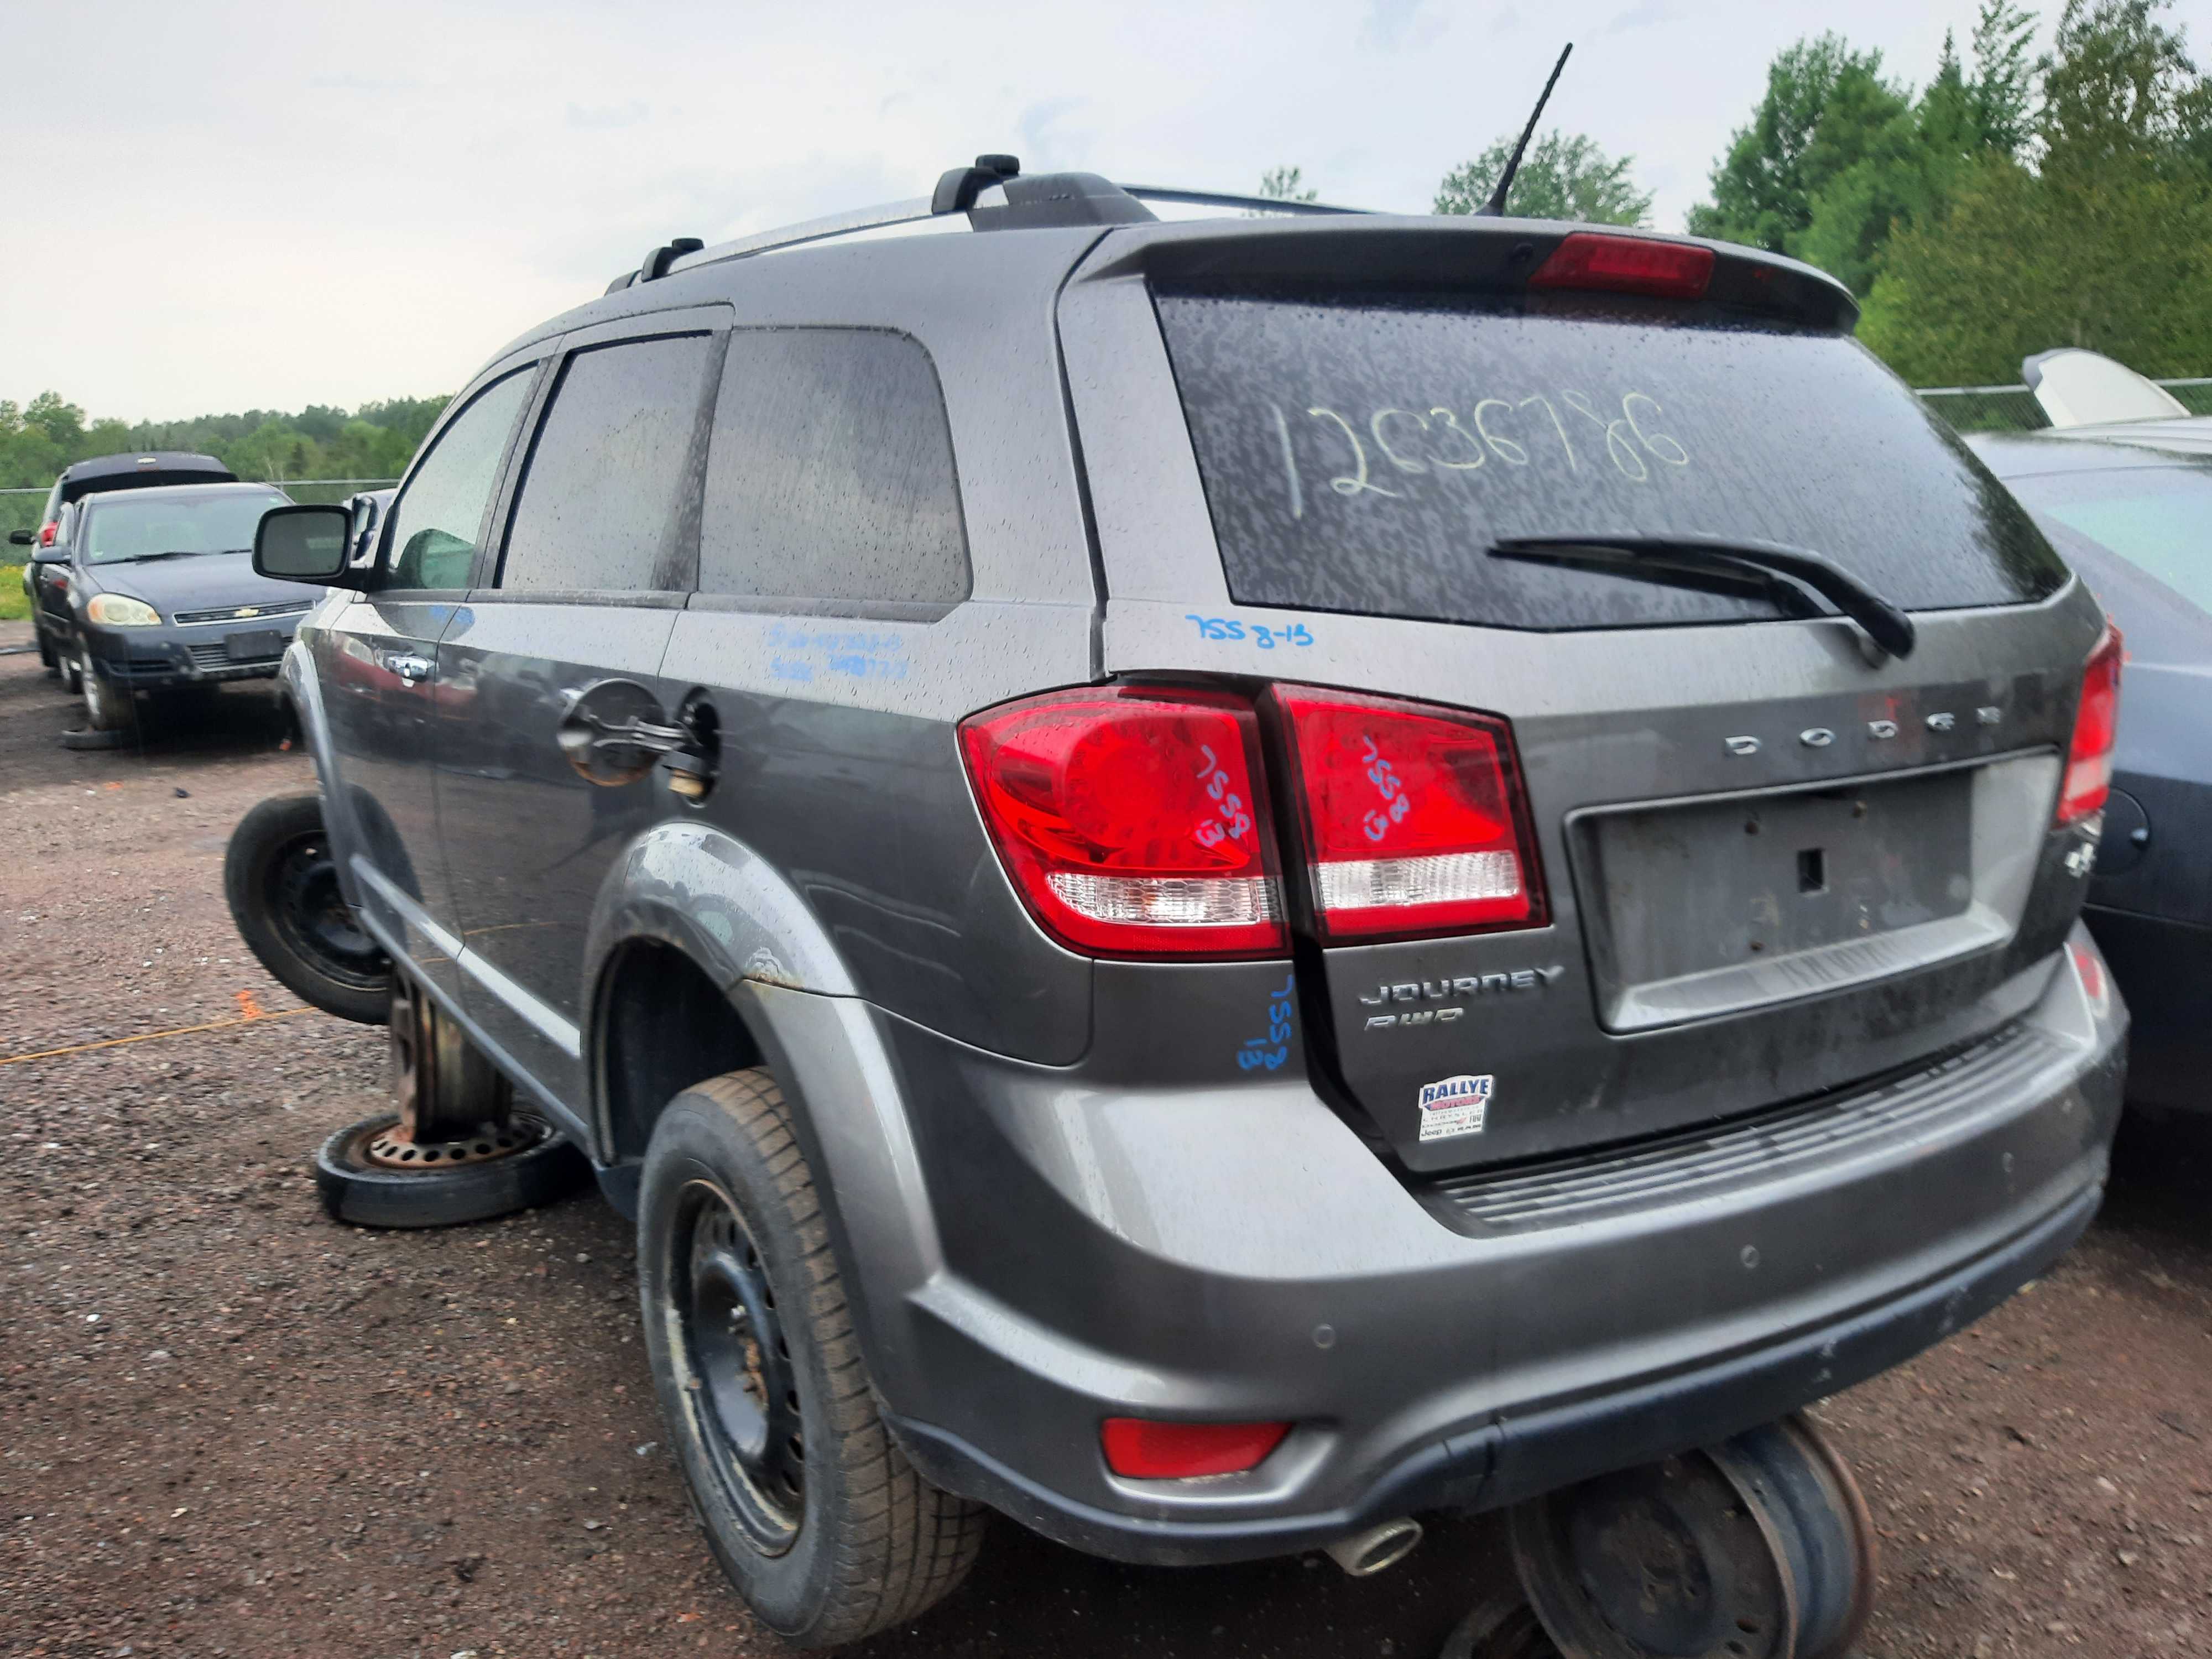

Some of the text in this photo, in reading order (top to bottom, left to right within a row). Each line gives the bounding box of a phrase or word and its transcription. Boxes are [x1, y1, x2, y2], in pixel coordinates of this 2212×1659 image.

[1359, 964, 1566, 1005] JOURNEY
[1363, 1006, 1465, 1031] AWD
[1422, 1078, 1490, 1105] RALLYE
